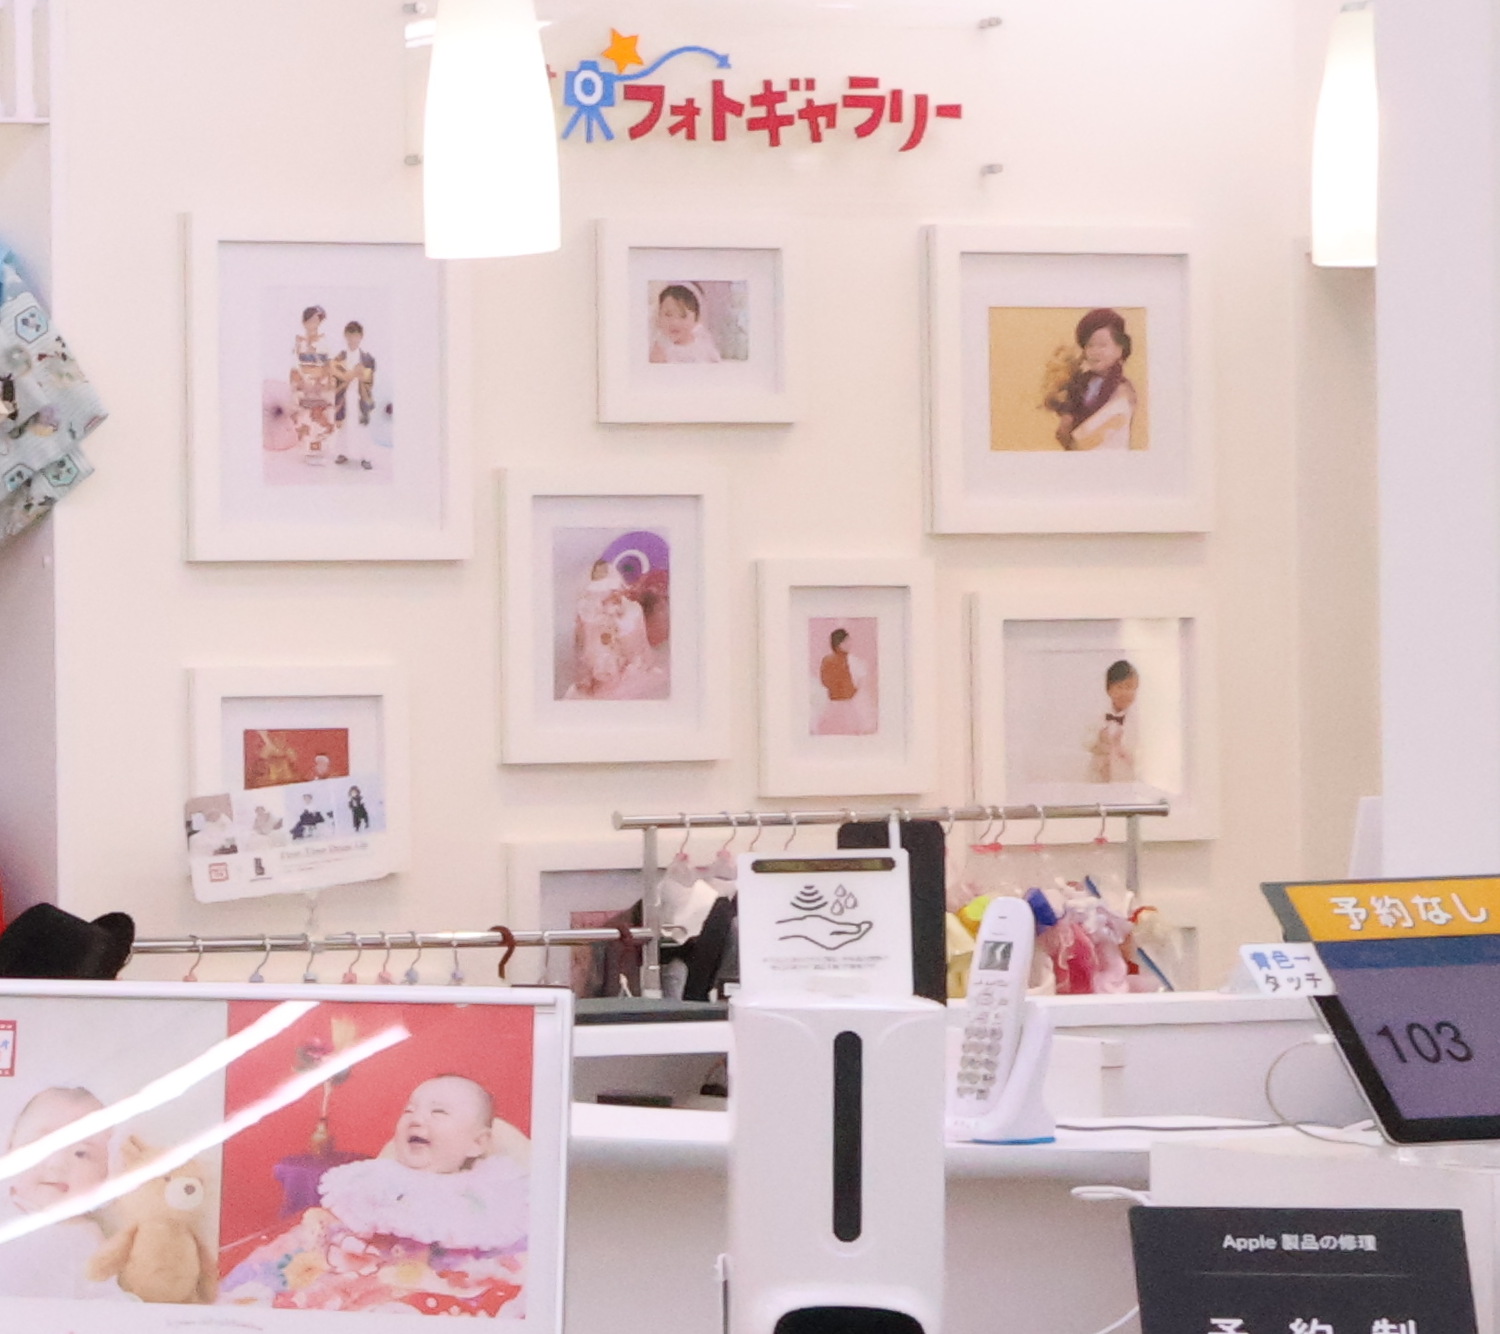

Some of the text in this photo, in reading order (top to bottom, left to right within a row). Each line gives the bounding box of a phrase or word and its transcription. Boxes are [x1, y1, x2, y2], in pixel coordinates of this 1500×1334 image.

[622, 75, 963, 153] フォトギャラリー
[1329, 892, 1488, 931] 予約なし
[1377, 1020, 1475, 1064] 103
[1222, 1233, 1378, 1253] Apple 製品の修理
